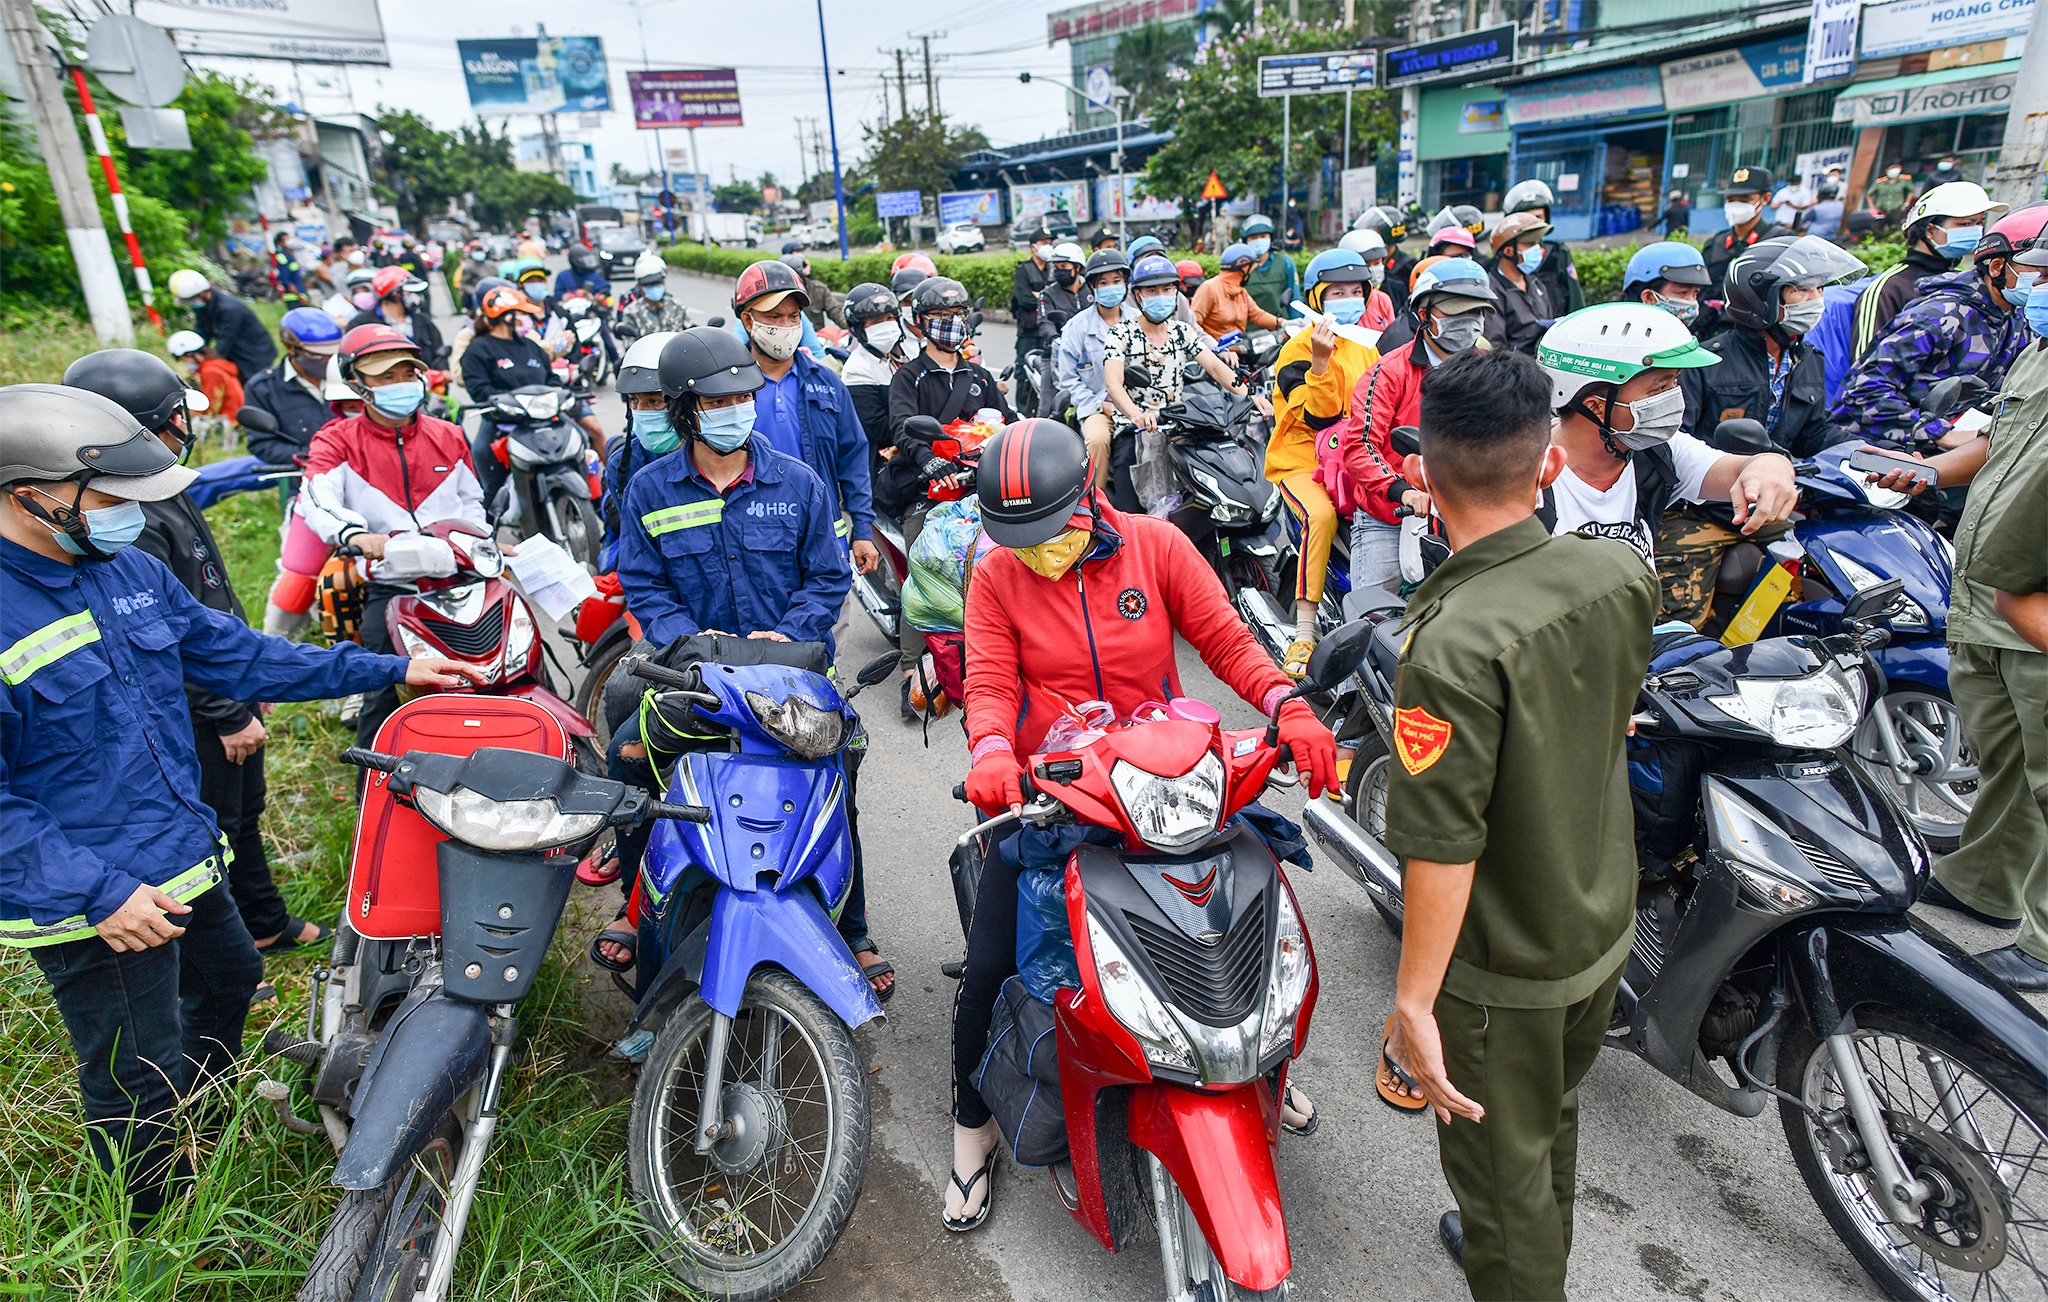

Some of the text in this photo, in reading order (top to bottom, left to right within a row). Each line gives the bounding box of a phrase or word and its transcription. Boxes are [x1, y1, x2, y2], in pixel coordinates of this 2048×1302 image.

[766, 502, 798, 516] HBC
[1009, 498, 1032, 506] YAMAHA
[1787, 615, 1818, 630] HONDA
